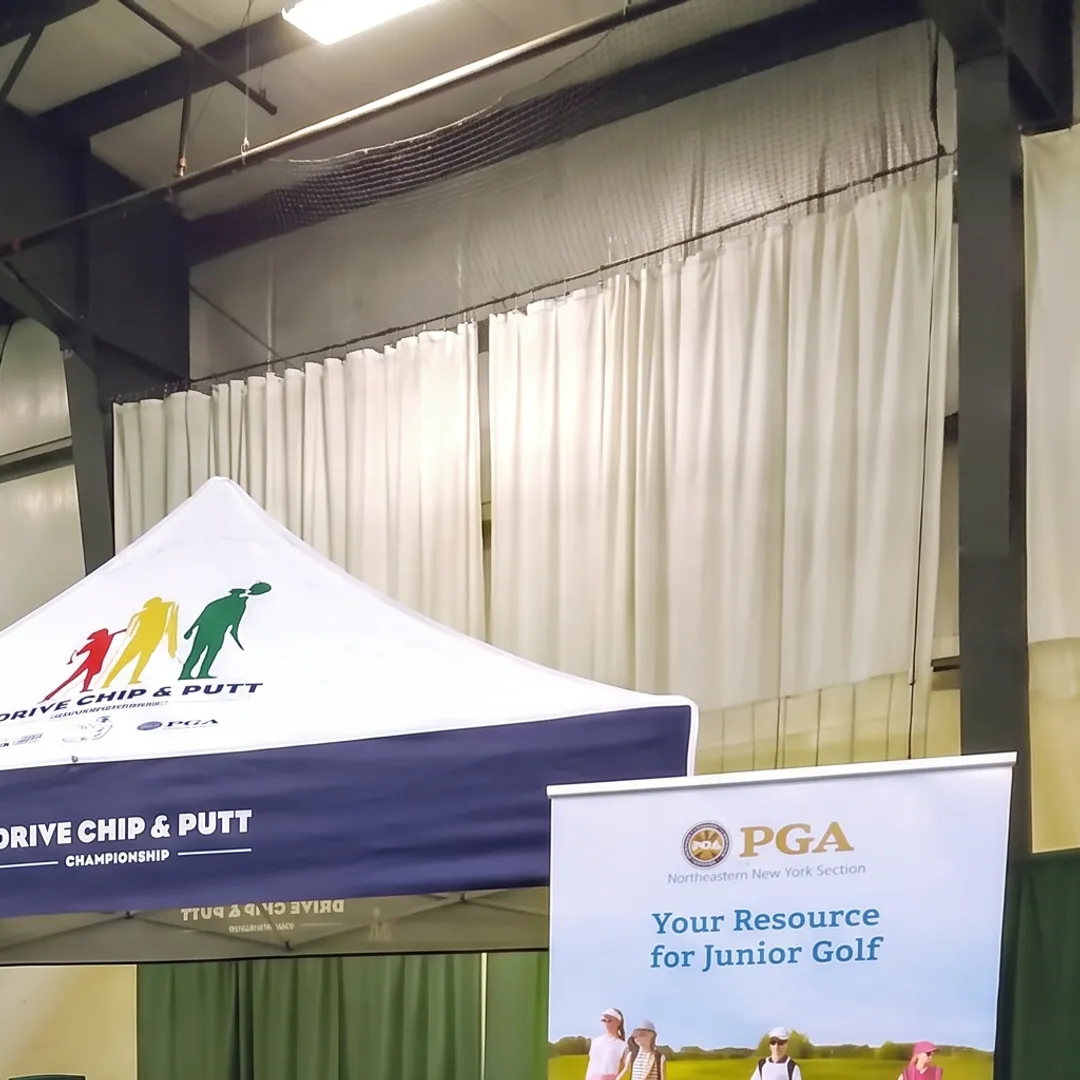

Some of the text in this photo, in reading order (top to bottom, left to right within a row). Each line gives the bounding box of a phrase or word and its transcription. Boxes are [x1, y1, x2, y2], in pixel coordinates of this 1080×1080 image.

[76, 688, 148, 706] CHIP
[152, 686, 172, 697] &
[181, 682, 264, 695] PUTT
[77, 815, 145, 844] CHIP
[150, 814, 171, 839] &
[177, 808, 253, 836] PUTT
[738, 821, 855, 858] PGA
[64, 848, 170, 868] CHAMPIONSHIP
[667, 862, 867, 884] Northeastern New York Section
[651, 907, 881, 935] Your Resource
[650, 936, 885, 973] for Junior Golf
